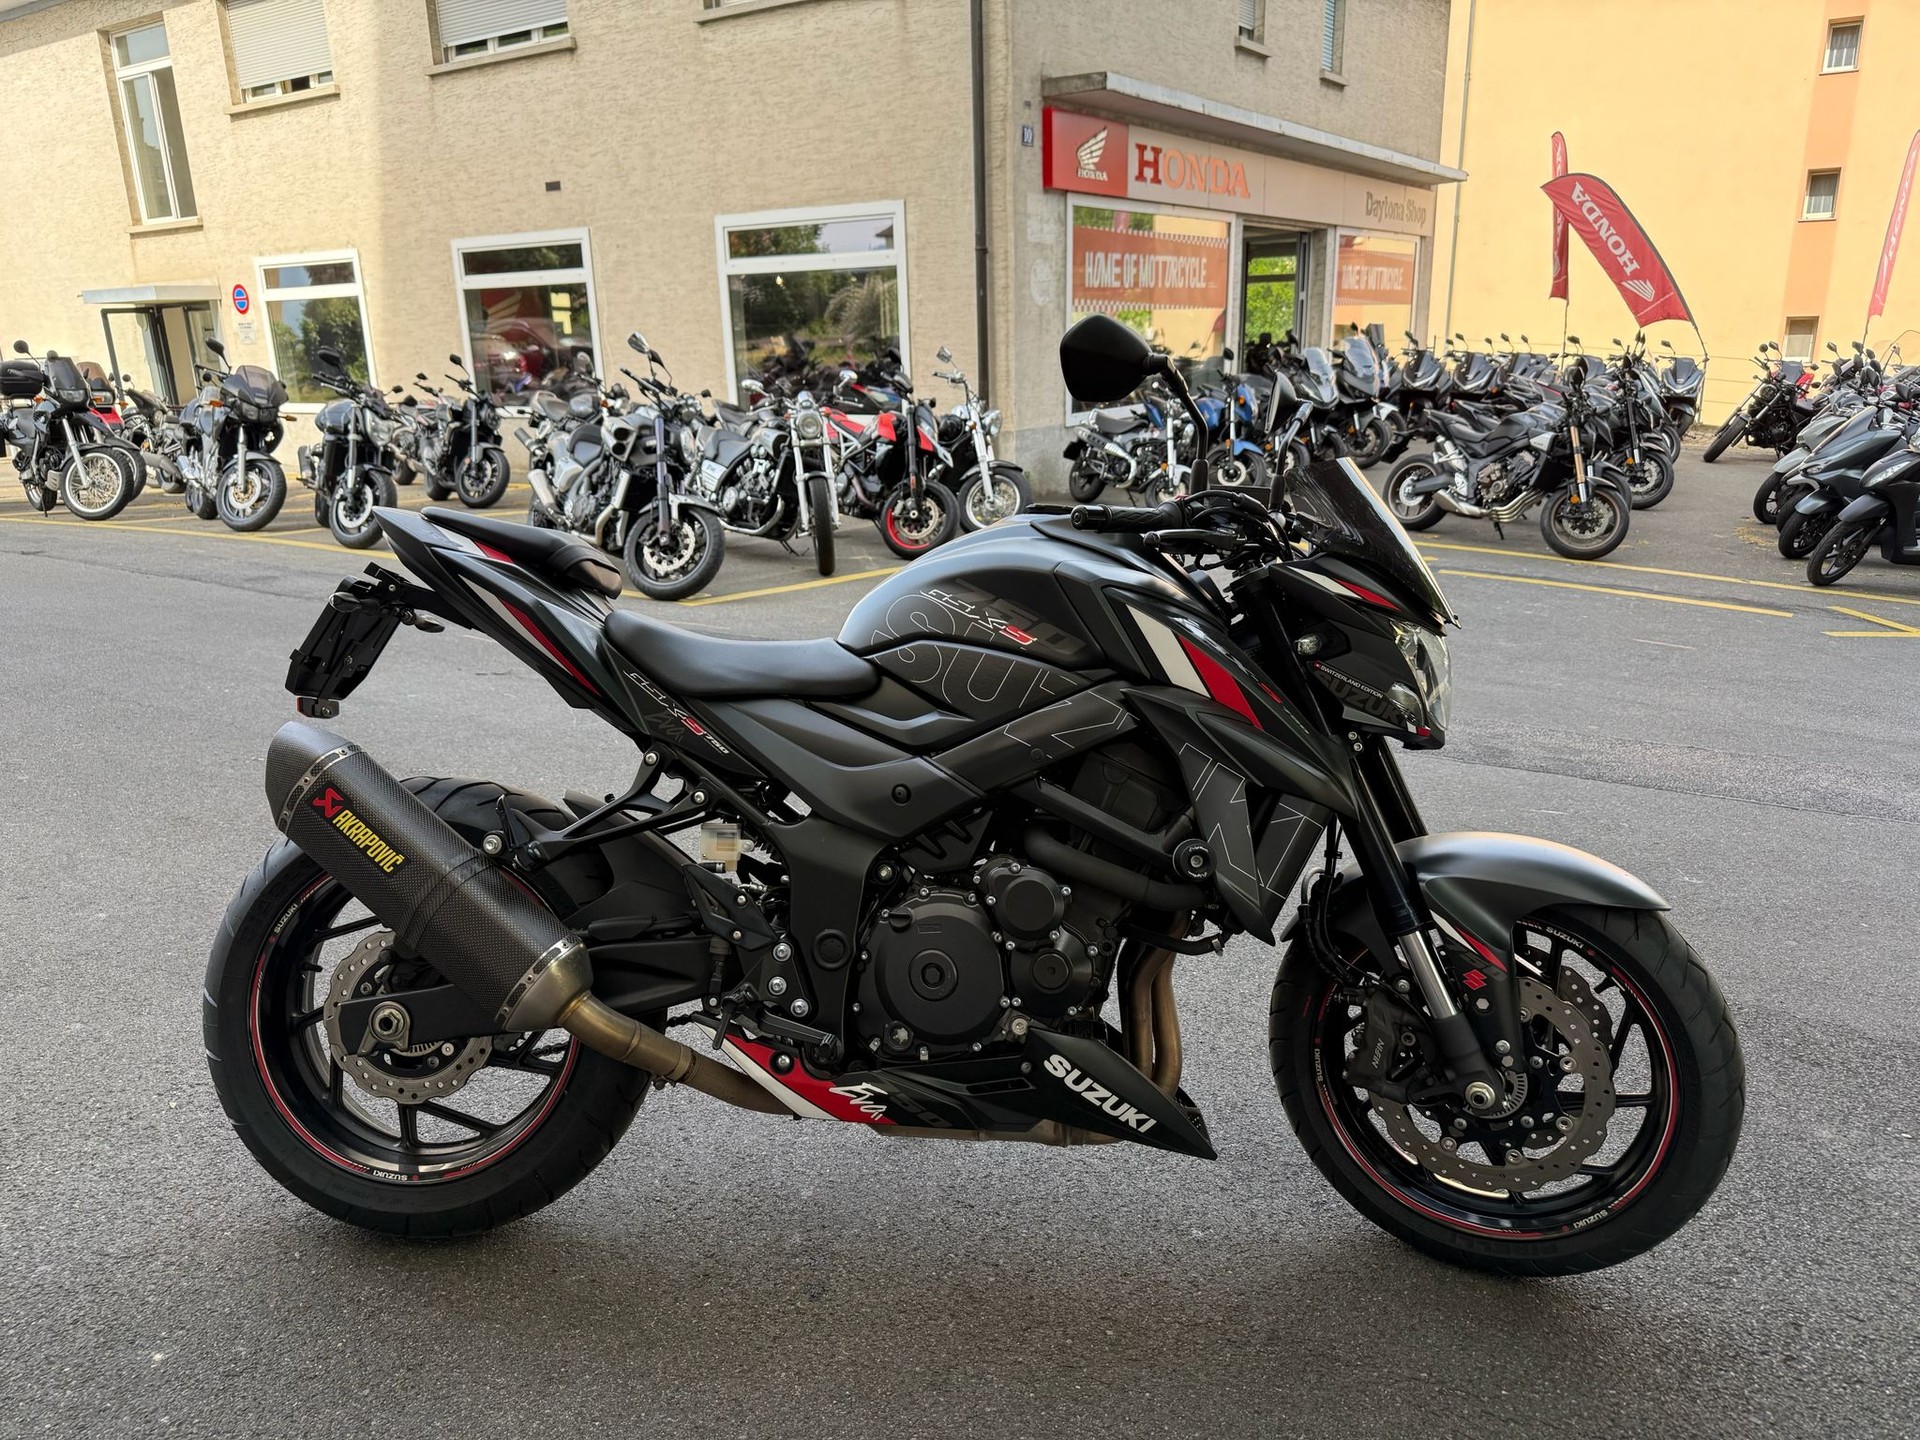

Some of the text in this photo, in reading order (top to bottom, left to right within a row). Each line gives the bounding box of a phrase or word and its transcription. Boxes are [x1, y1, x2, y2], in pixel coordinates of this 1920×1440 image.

[1077, 168, 1108, 181] HONDA
[1134, 142, 1251, 199] HONDA
[1365, 191, 1427, 229] Daytona Shop
[1571, 181, 1640, 276] HONDA
[1085, 251, 1121, 288] HOME
[1123, 253, 1137, 288] OF
[1320, 665, 1384, 699] SWITZERLAND EDITION
[273, 902, 299, 934] SUZUKI
[1545, 926, 1584, 949] SUZUKI
[1314, 1048, 1324, 1082] SUZUKI
[1043, 1054, 1158, 1133] SUZUKI
[372, 1169, 409, 1182] SUZUKI
[1573, 1208, 1609, 1230] SUZUKI
